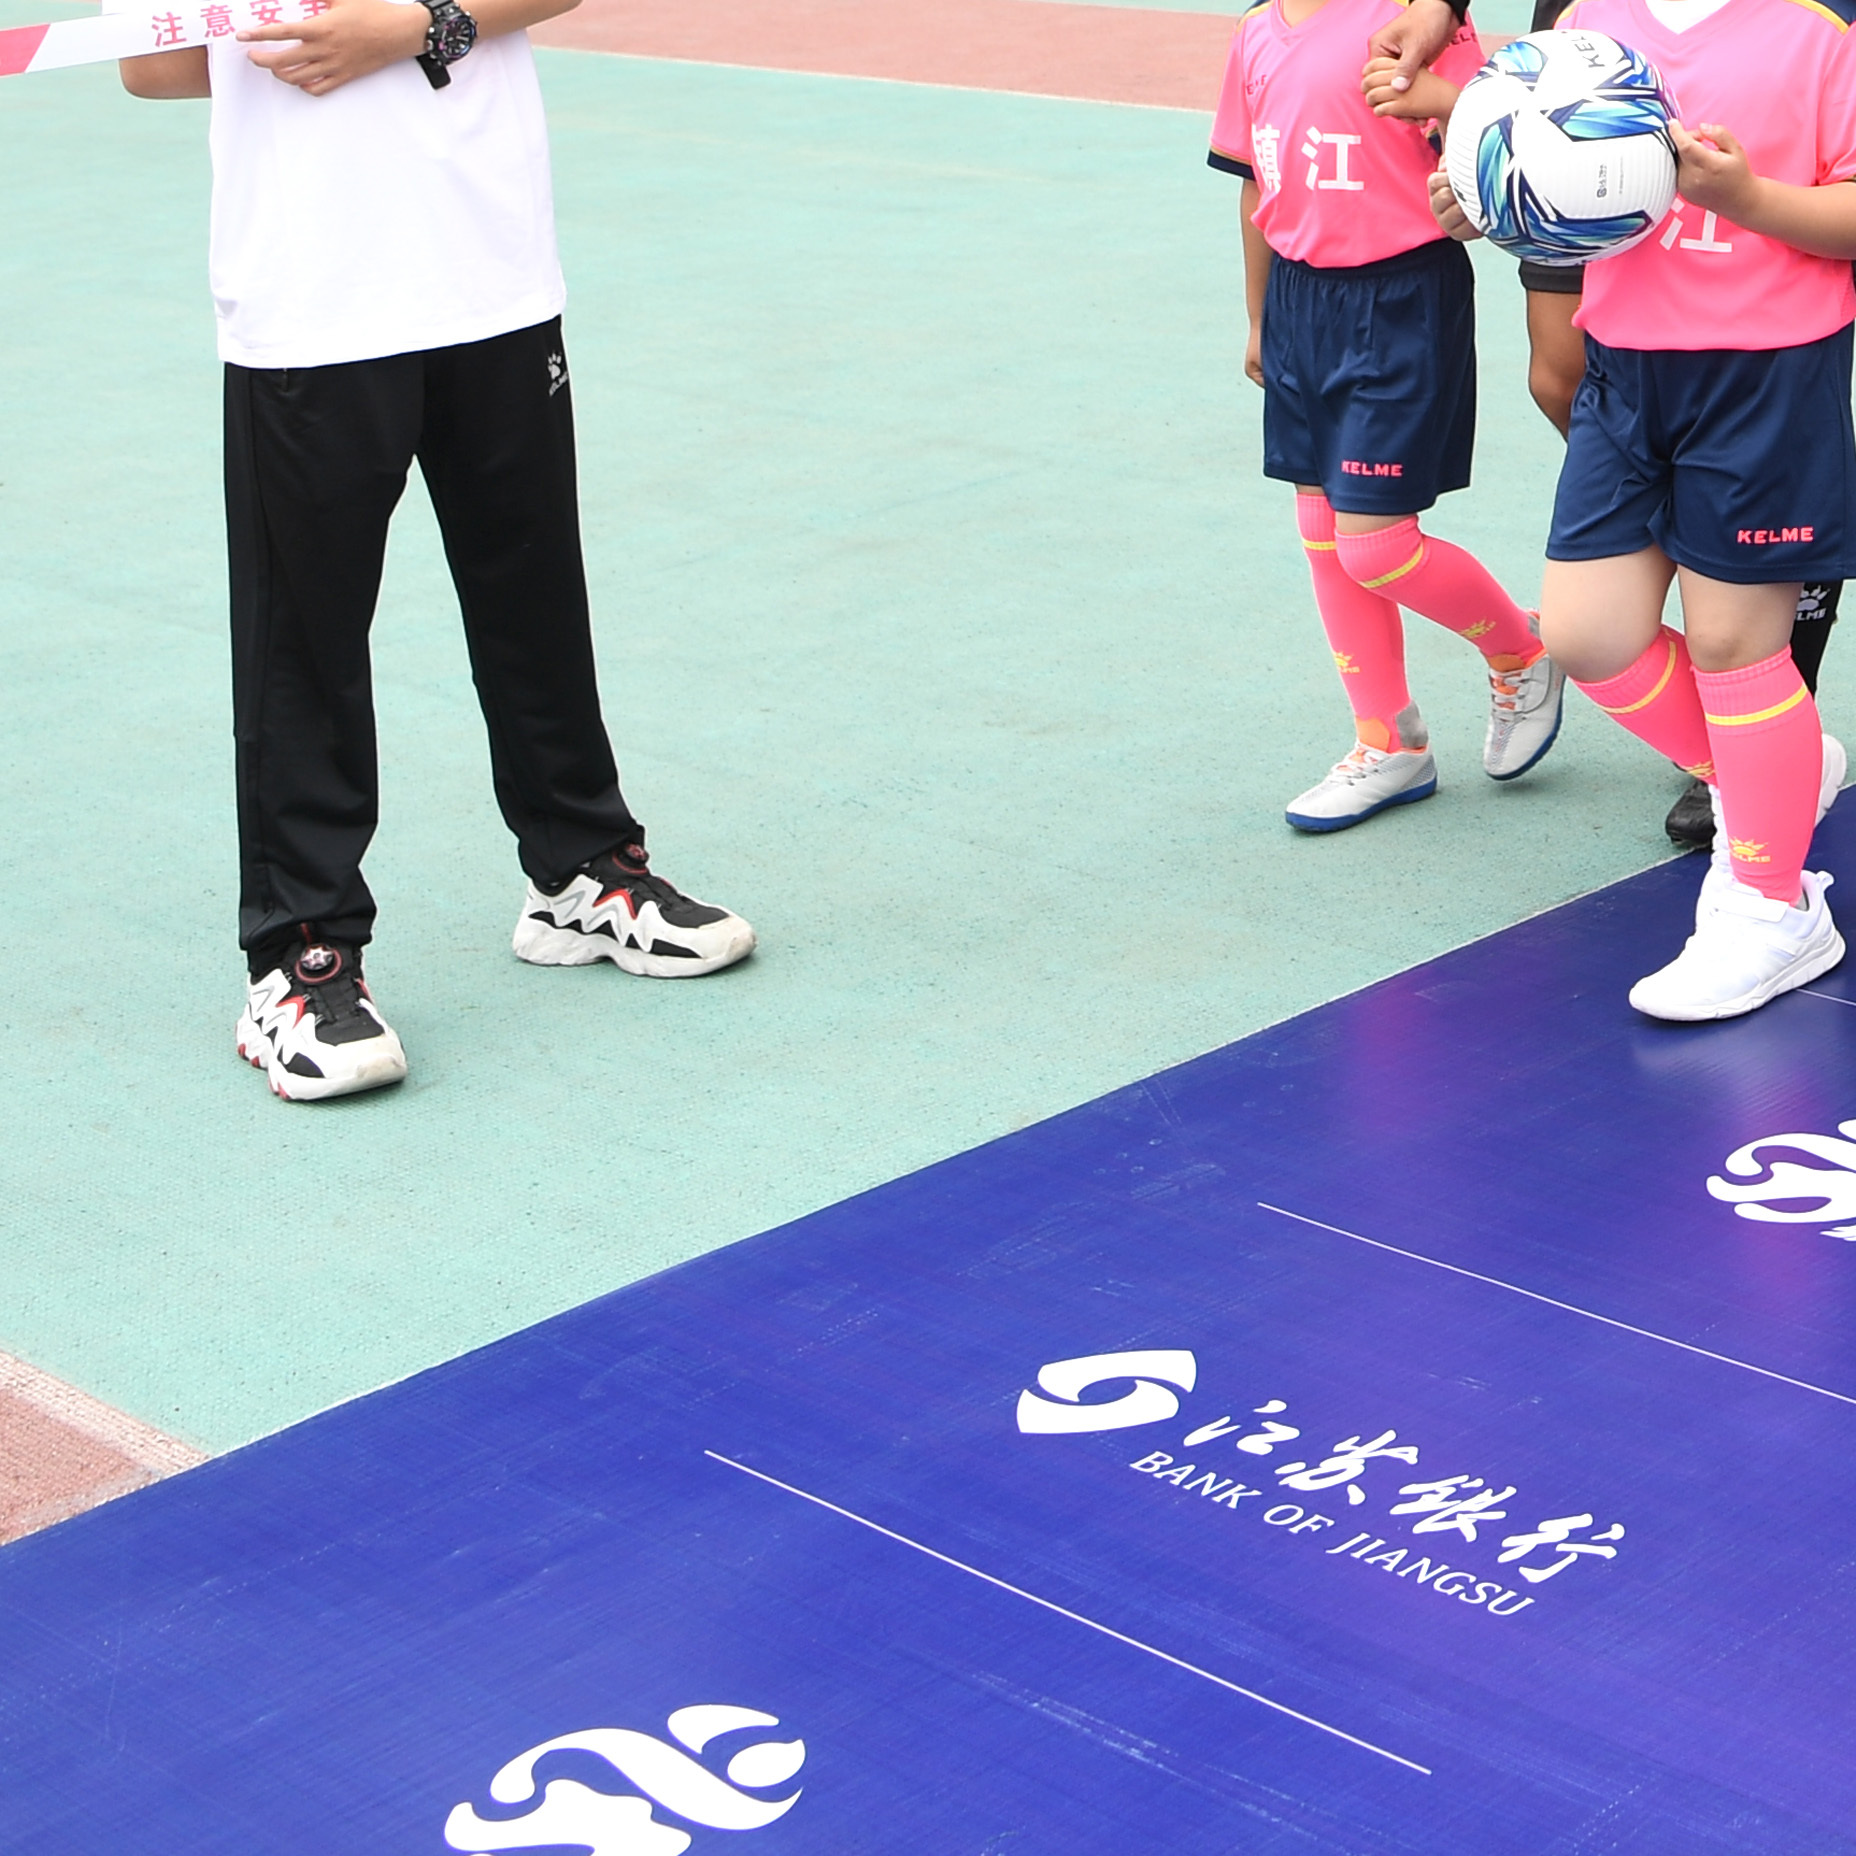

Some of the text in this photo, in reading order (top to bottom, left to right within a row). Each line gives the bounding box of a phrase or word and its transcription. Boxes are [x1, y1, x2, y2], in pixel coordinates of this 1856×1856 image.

[1341, 459, 1404, 477] KELME
[1737, 526, 1815, 545] KELME
[1129, 1449, 1537, 1617] BANK OF JIANGSU
[1182, 1398, 1626, 1584] 江苏银行
